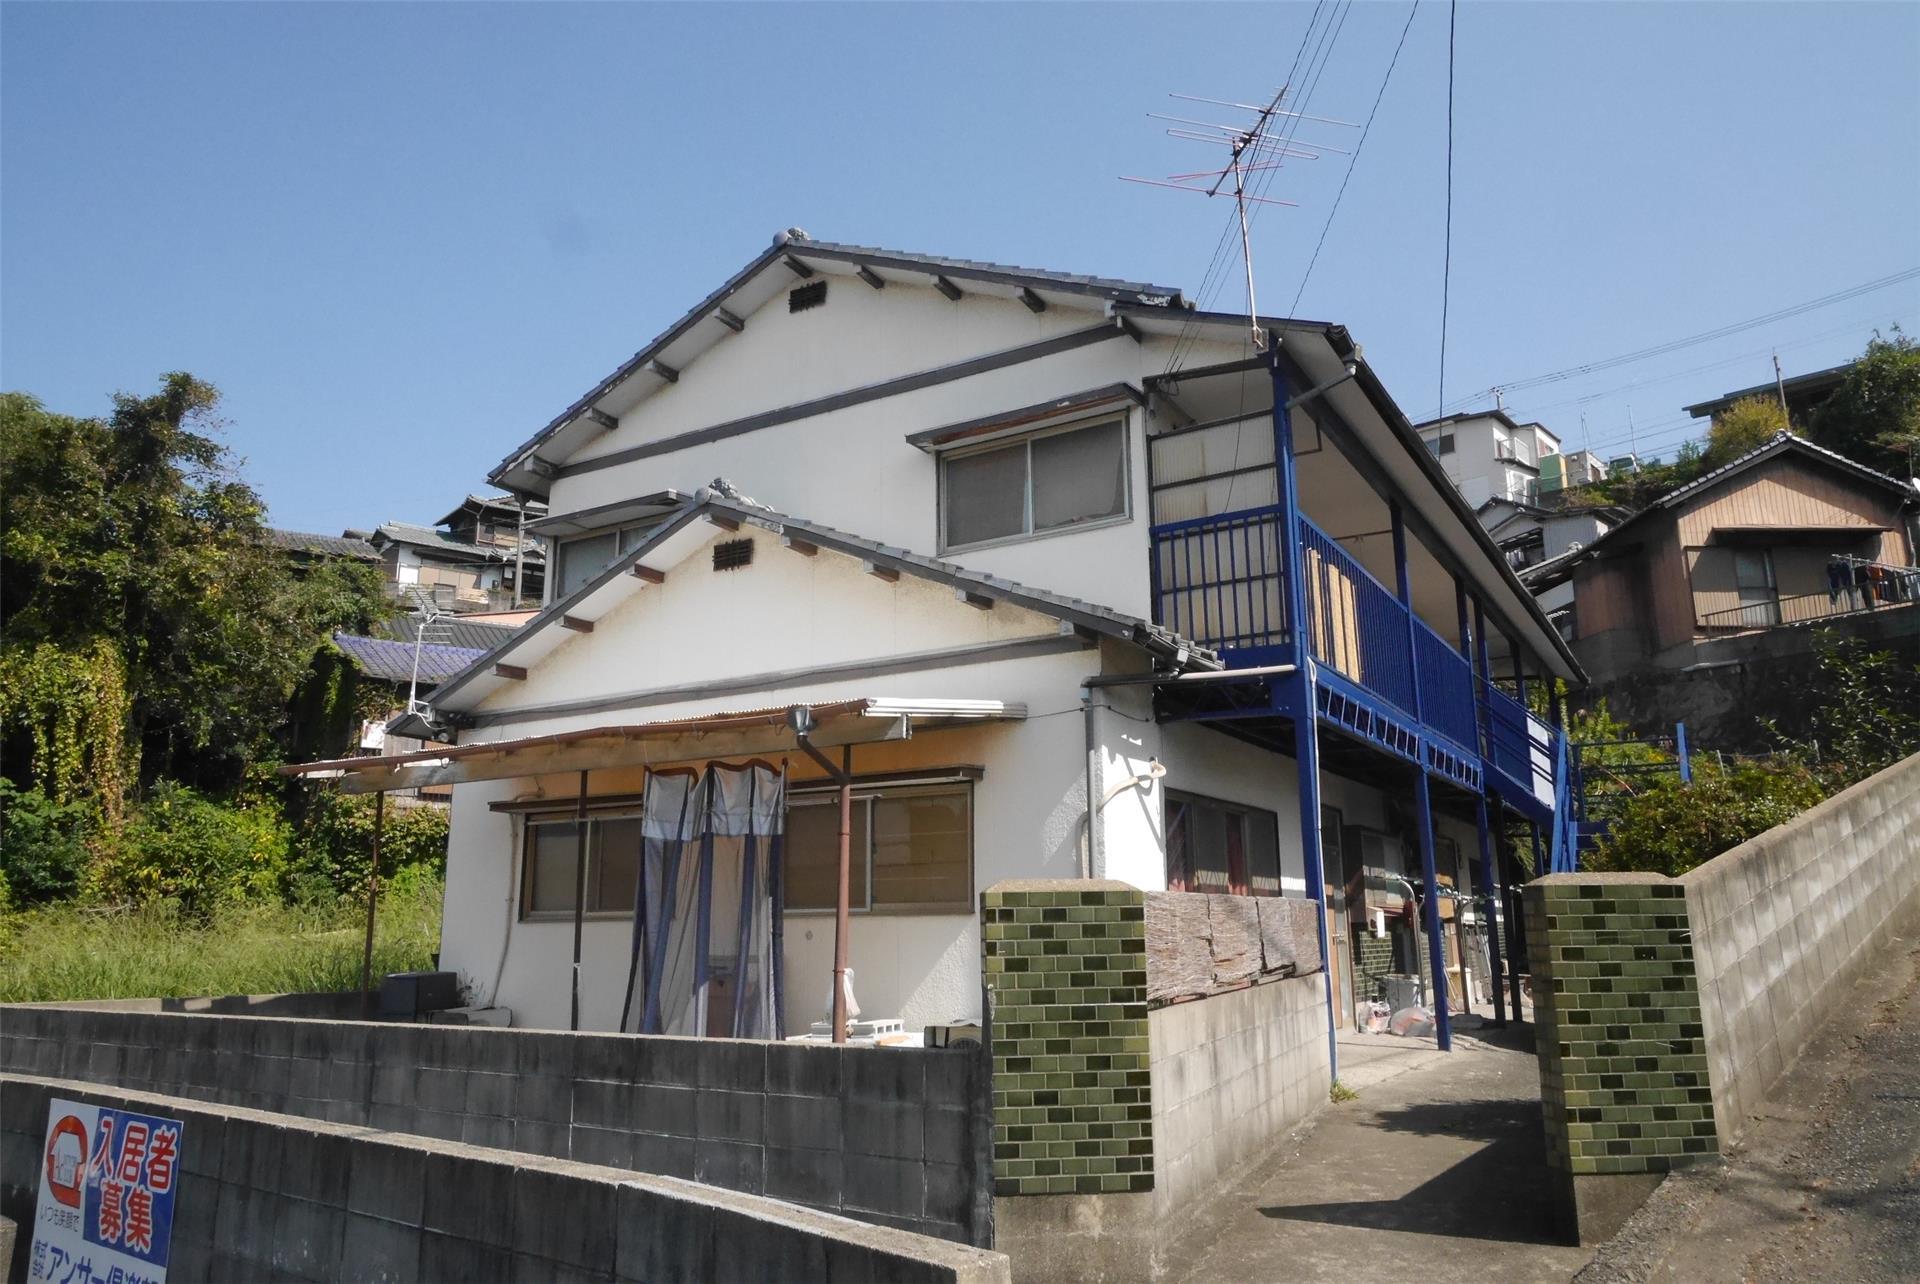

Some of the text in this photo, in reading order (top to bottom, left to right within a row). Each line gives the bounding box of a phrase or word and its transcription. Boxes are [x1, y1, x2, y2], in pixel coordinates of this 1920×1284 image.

[91, 1117, 177, 1193] 入居者
[100, 1179, 152, 1253] 募集
[47, 1246, 159, 1284] アンサー倶
